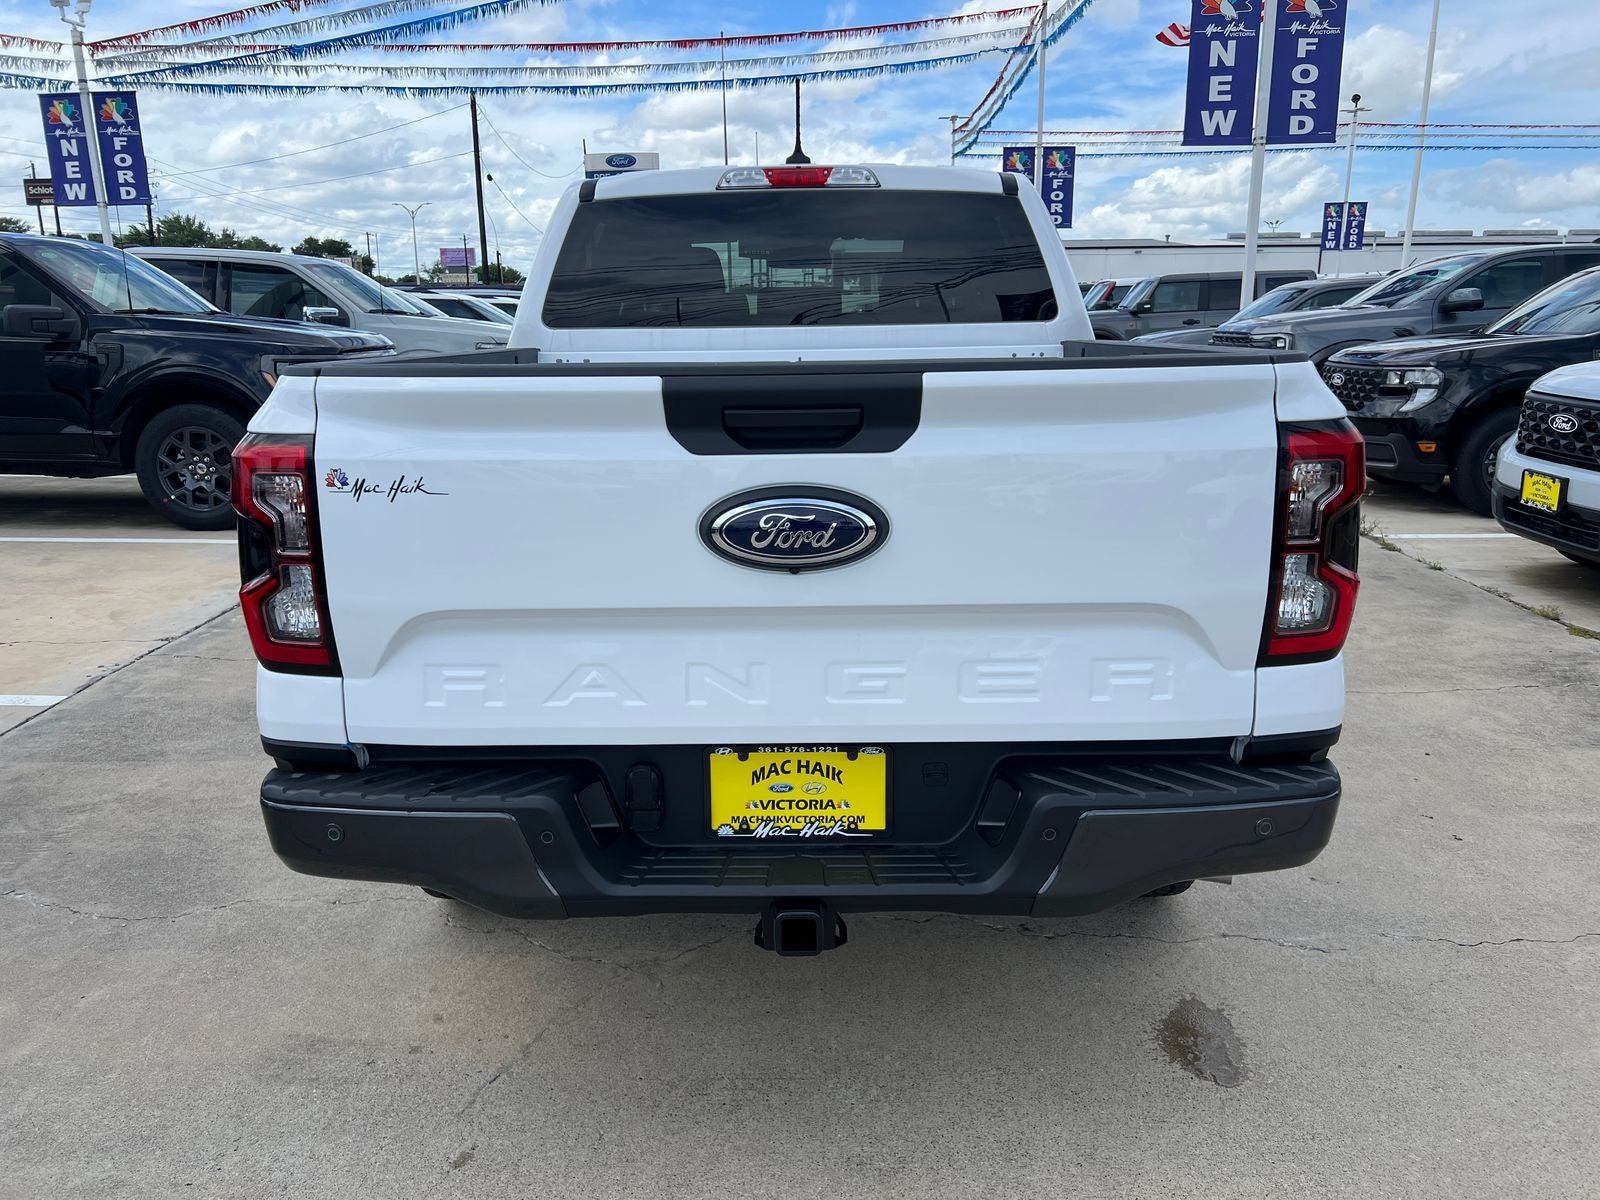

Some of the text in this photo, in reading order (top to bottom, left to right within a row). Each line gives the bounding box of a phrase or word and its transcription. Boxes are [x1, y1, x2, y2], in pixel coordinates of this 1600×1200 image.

[1204, 21, 1250, 38] Mac Haik
[1289, 19, 1334, 35] Mac Haik
[1200, 40, 1237, 136] NEW
[1289, 37, 1319, 136] FORD
[60, 139, 87, 201] NEW
[113, 137, 136, 199] FORD
[611, 157, 630, 165] Ford
[1050, 179, 1064, 225] FORD
[1325, 222, 1336, 248] NEW
[1349, 221, 1358, 248] FORD
[1553, 416, 1573, 431] Ford
[346, 474, 436, 503] Mac Haik
[750, 512, 838, 549] Ford
[423, 657, 1174, 708] RANGER
[751, 759, 844, 786] MAC HAIK
[772, 784, 791, 792] Ford
[759, 799, 837, 810] VICTORIA
[751, 821, 855, 838] Mac Haik
